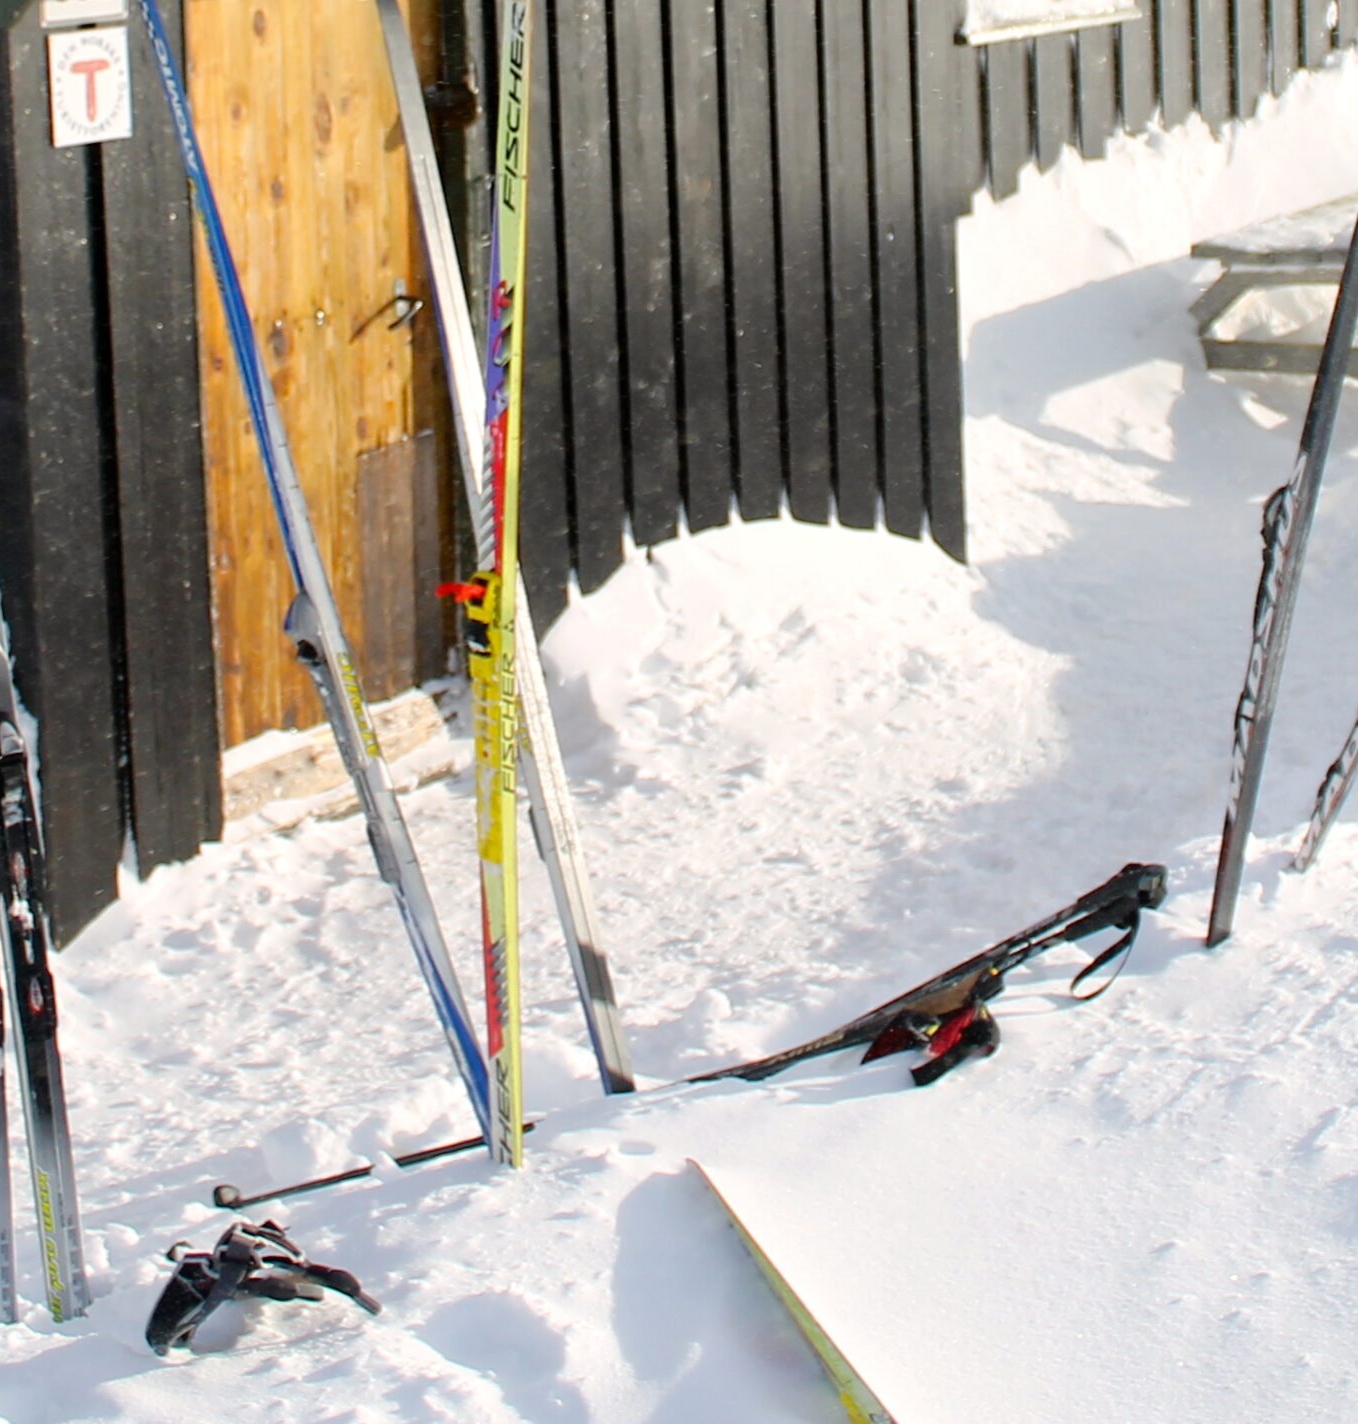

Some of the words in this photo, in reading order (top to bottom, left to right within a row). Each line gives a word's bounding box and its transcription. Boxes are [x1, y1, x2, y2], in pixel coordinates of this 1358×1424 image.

[70, 59, 112, 123] T
[154, 37, 199, 176] ATOMIC
[502, 2, 527, 212] FISCHER
[1227, 452, 1309, 824] MADSHUS
[502, 653, 515, 795] FISCHER
